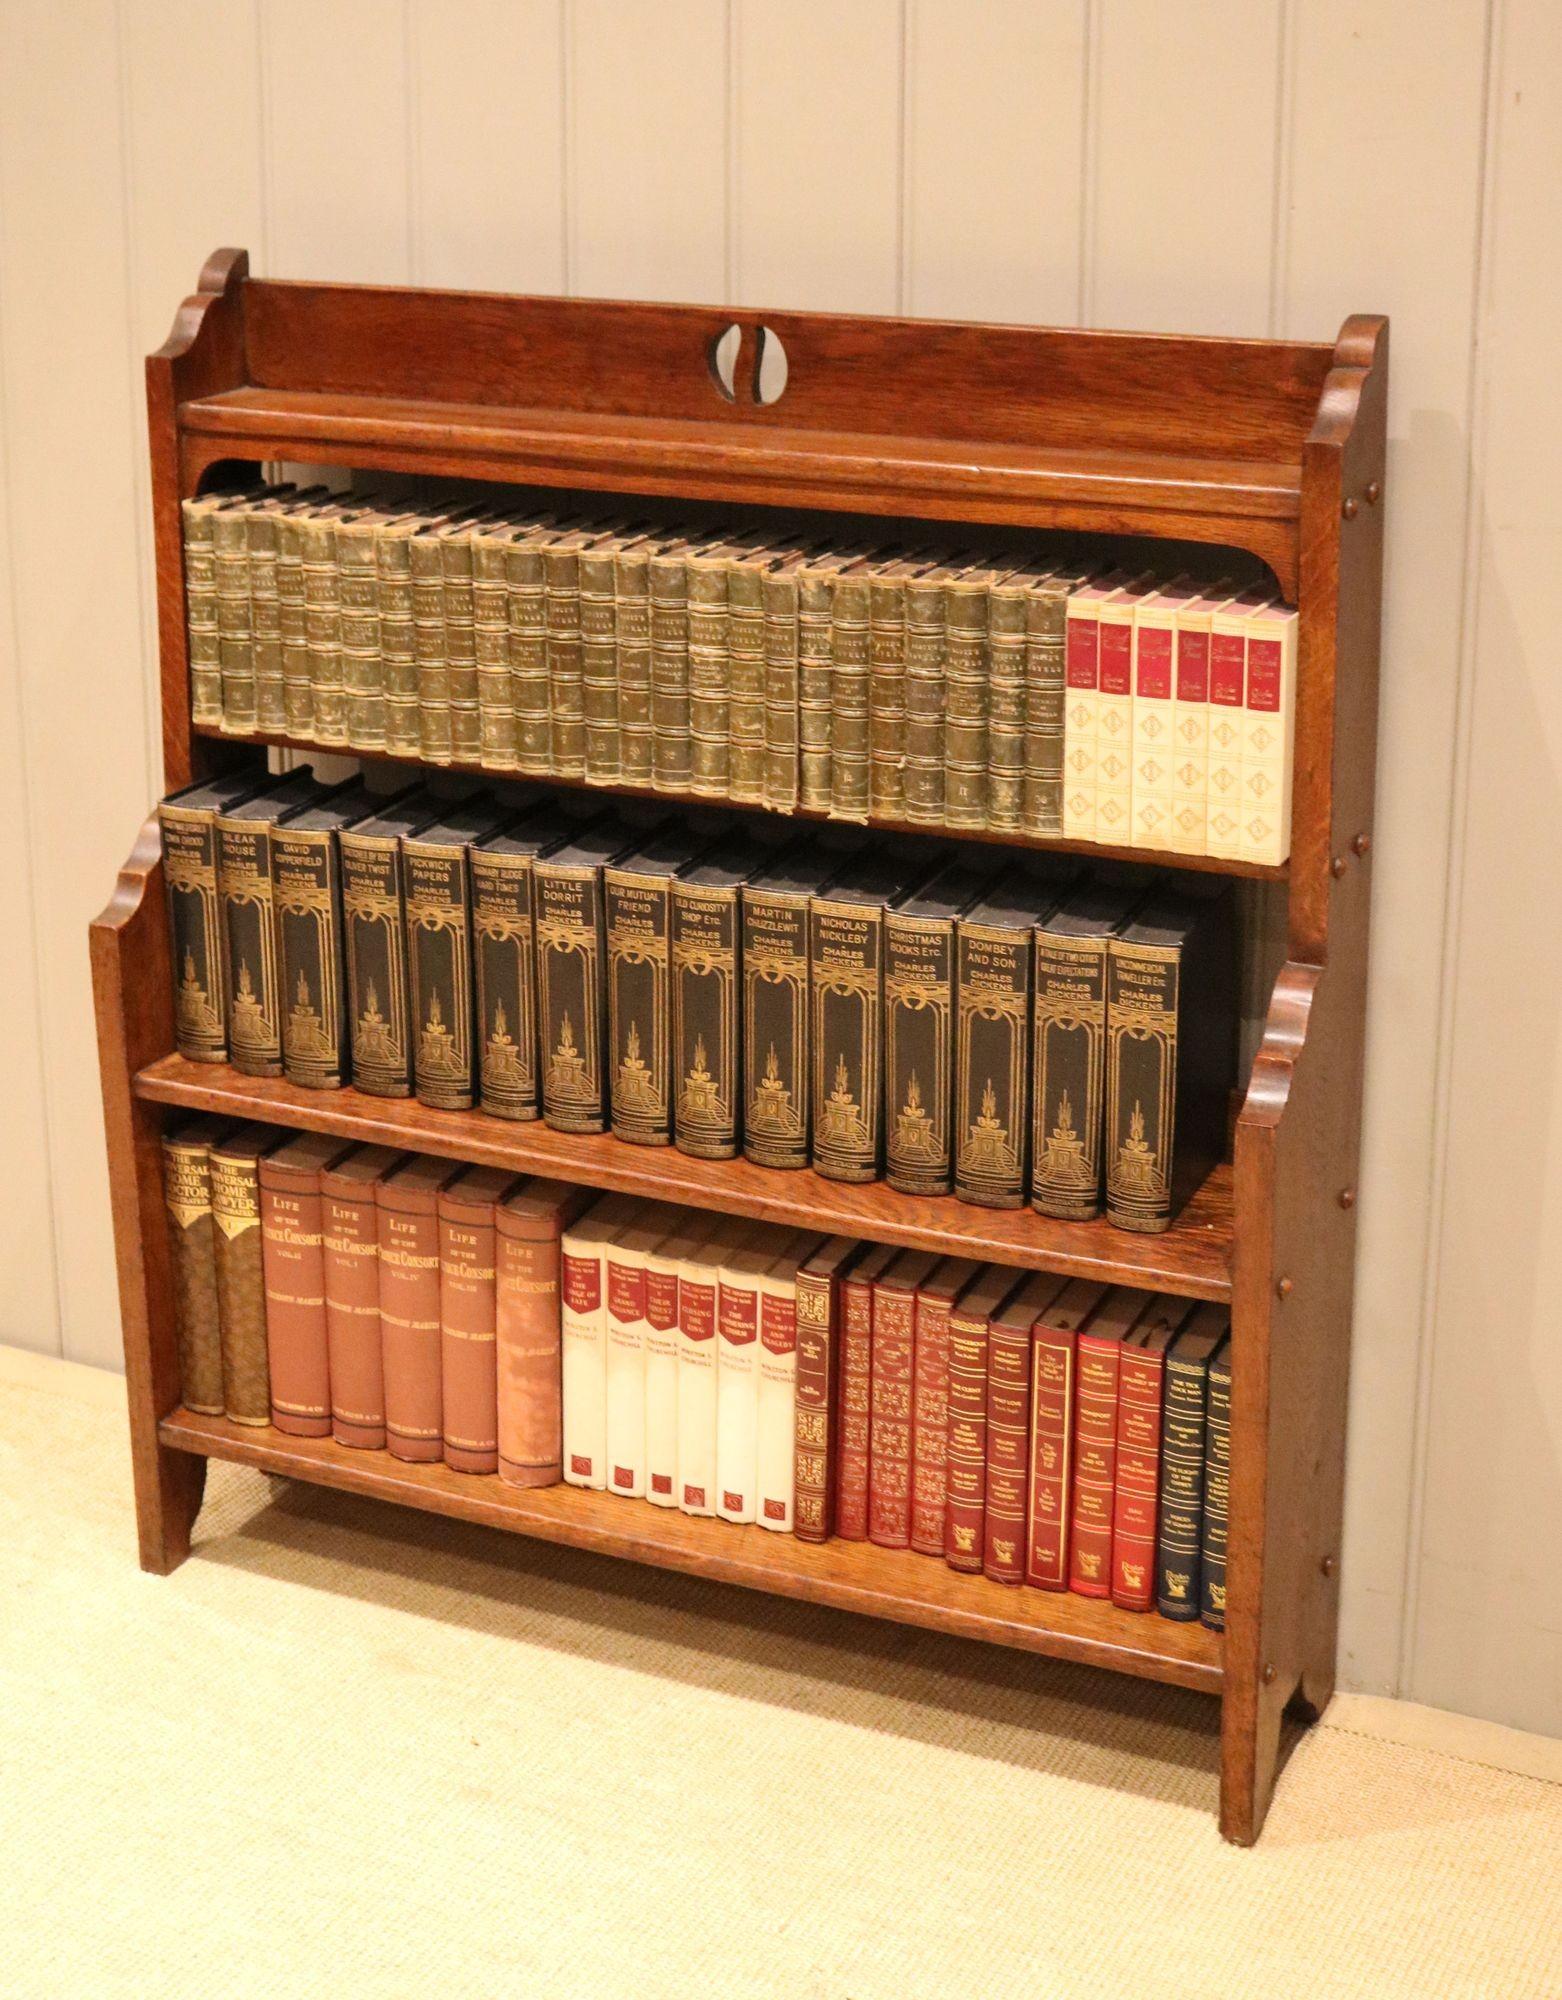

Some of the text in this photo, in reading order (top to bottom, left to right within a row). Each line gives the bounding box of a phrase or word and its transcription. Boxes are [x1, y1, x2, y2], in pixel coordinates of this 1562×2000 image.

[222, 832, 256, 844] BLEAK
[222, 844, 257, 857] HOUSE
[283, 843, 310, 855] DAVID
[368, 863, 391, 875] TWIST
[409, 858, 453, 871] PICKWICK
[412, 869, 449, 882] PAPERS
[413, 885, 450, 896] CHARLES
[495, 881, 520, 893] TIMES
[543, 879, 583, 893] LITTLE
[479, 894, 518, 906] CHARLES
[543, 890, 584, 903] DORRIT
[609, 887, 661, 903] OUR MUTUAL
[479, 903, 519, 914] DICKENS
[544, 907, 583, 918] CHARLES
[617, 900, 652, 914] FRIEND
[675, 898, 728, 914] OLD CURIOSITY
[681, 911, 702, 924] SHOP
[752, 906, 793, 921] MARTIN
[544, 915, 584, 926] DICKENS
[614, 916, 655, 929] CHARLES
[747, 917, 799, 934] CHUZZLEWIT
[820, 917, 869, 932] NICHOLAS
[614, 924, 655, 937] DICKENS
[680, 928, 721, 940] CHARLES
[819, 929, 869, 945] NICKLEBY
[680, 936, 722, 949] DICKENS
[753, 935, 794, 948] CHARLES
[889, 929, 943, 946] CHRISTMAS
[753, 943, 795, 956] DICKENS
[822, 947, 865, 960] CHARLES
[890, 942, 921, 957] BOOKS
[968, 939, 1017, 956] DOMBEY
[822, 956, 866, 969] DICKENS
[894, 961, 937, 973] CHARLES
[967, 953, 1018, 970] AND SON
[1115, 957, 1167, 976] UNCOMMERCIAL
[894, 969, 938, 982] DICKENS
[969, 970, 1014, 984] CHARLES
[1116, 970, 1152, 986] TRAVELLER
[969, 979, 1015, 992] DICKENS
[1046, 980, 1091, 993] CHARLES
[1046, 989, 1092, 1002] DICKENS
[1119, 988, 1164, 1004] CHARLES
[1119, 998, 1165, 1012] DICKENS
[172, 1154, 191, 1165] THE
[219, 1164, 239, 1176] THE
[213, 1181, 249, 1198] HOME
